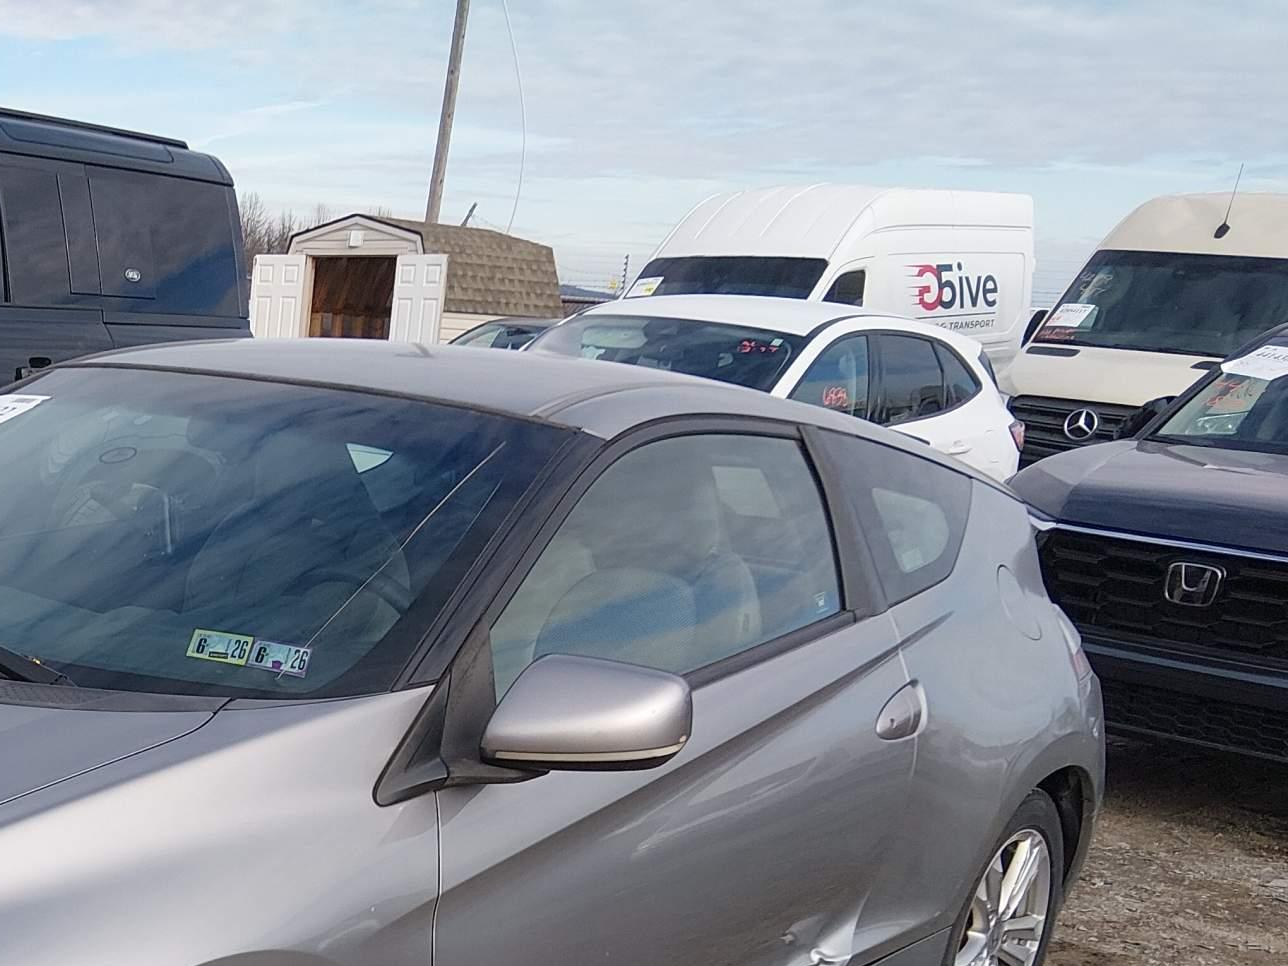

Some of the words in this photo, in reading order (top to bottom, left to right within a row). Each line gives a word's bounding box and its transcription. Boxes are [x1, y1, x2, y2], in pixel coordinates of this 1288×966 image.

[949, 319, 995, 331] TRANSPORT
[196, 638, 208, 654] 6
[231, 640, 249, 659] 26
[255, 646, 267, 663] 6
[290, 649, 309, 670] 26
